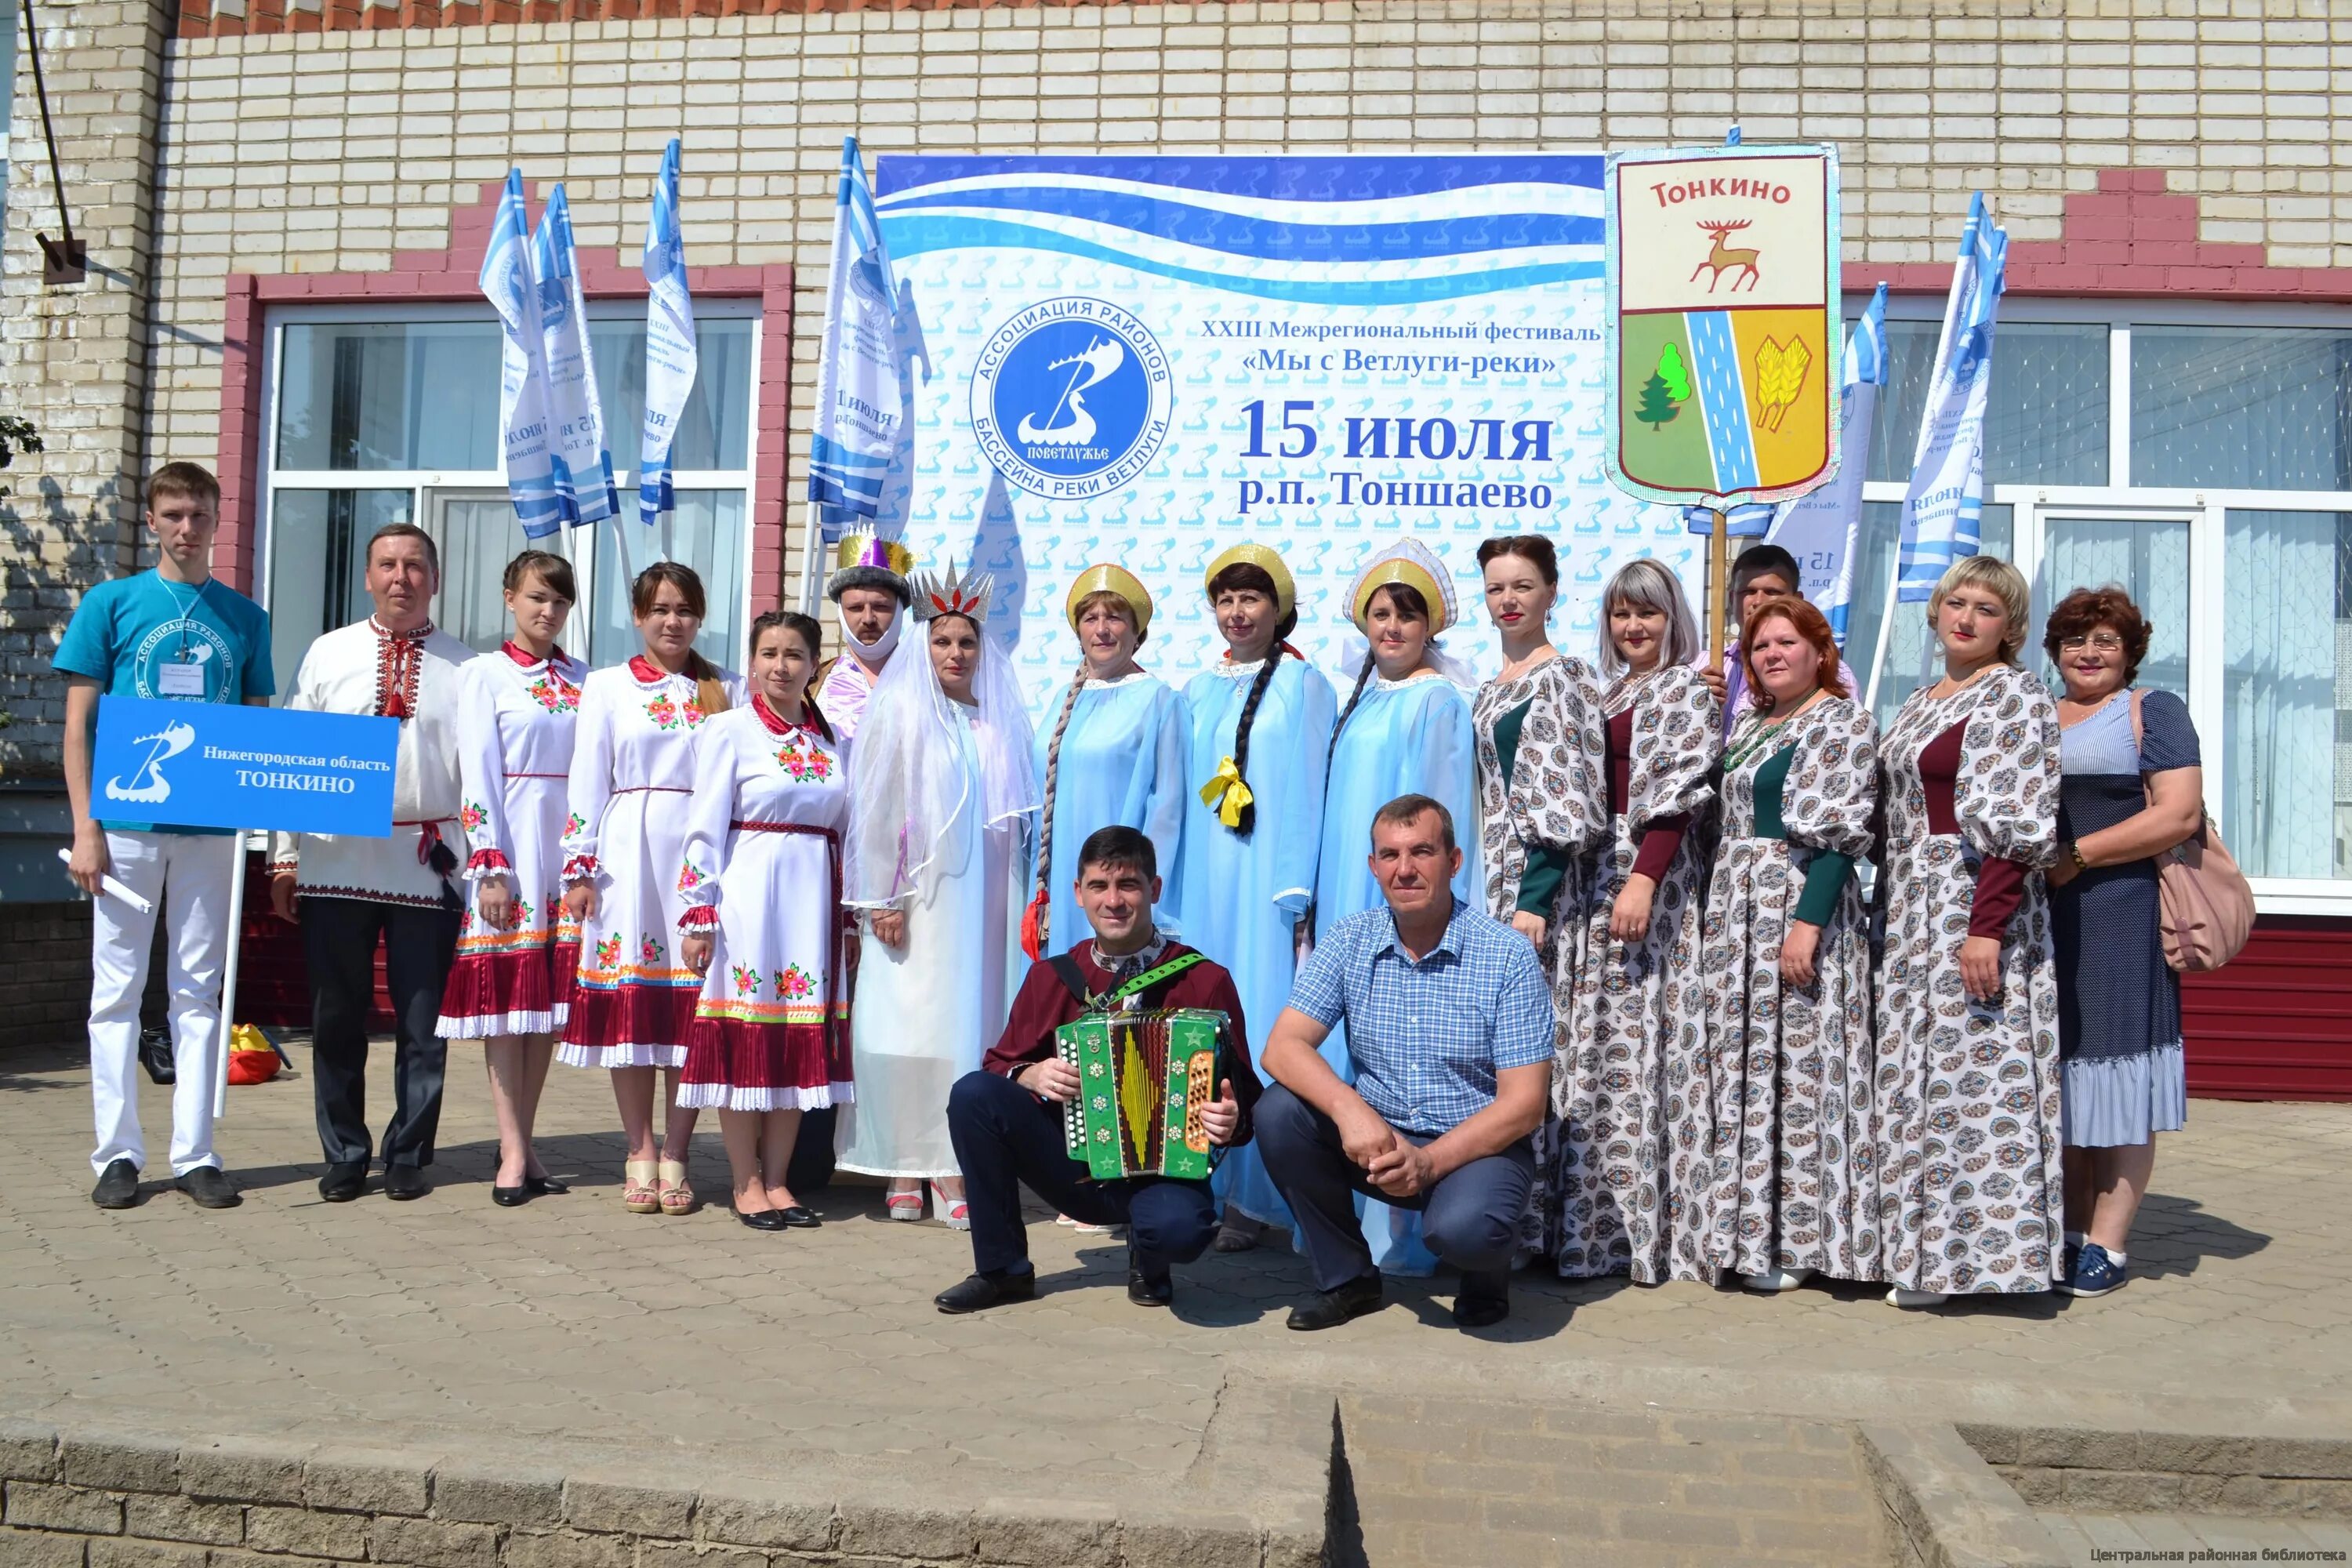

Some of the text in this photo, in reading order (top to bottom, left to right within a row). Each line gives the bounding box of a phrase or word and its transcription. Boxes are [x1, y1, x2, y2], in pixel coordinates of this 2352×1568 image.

[978, 301, 1166, 383] АССОЦИАЦИЯ РАЙОНОВ
[1269, 321, 1478, 342] Межрегиональный
[1484, 321, 1602, 343] фестиваль
[1243, 349, 1555, 378] «Мы с Ветлуги-реки»
[848, 396, 894, 426] июля
[1239, 400, 1554, 462] 15 июля
[975, 417, 1166, 495] БАССЕЙНА РЕКИ ВЕТЛУГИ
[1026, 447, 1110, 463] ПОВЕТЛУЖЬЕ
[1237, 471, 1552, 514] р.п. Тоншаево
[203, 746, 390, 771] Нижегородская область
[236, 770, 355, 793] ТОНКИНО
